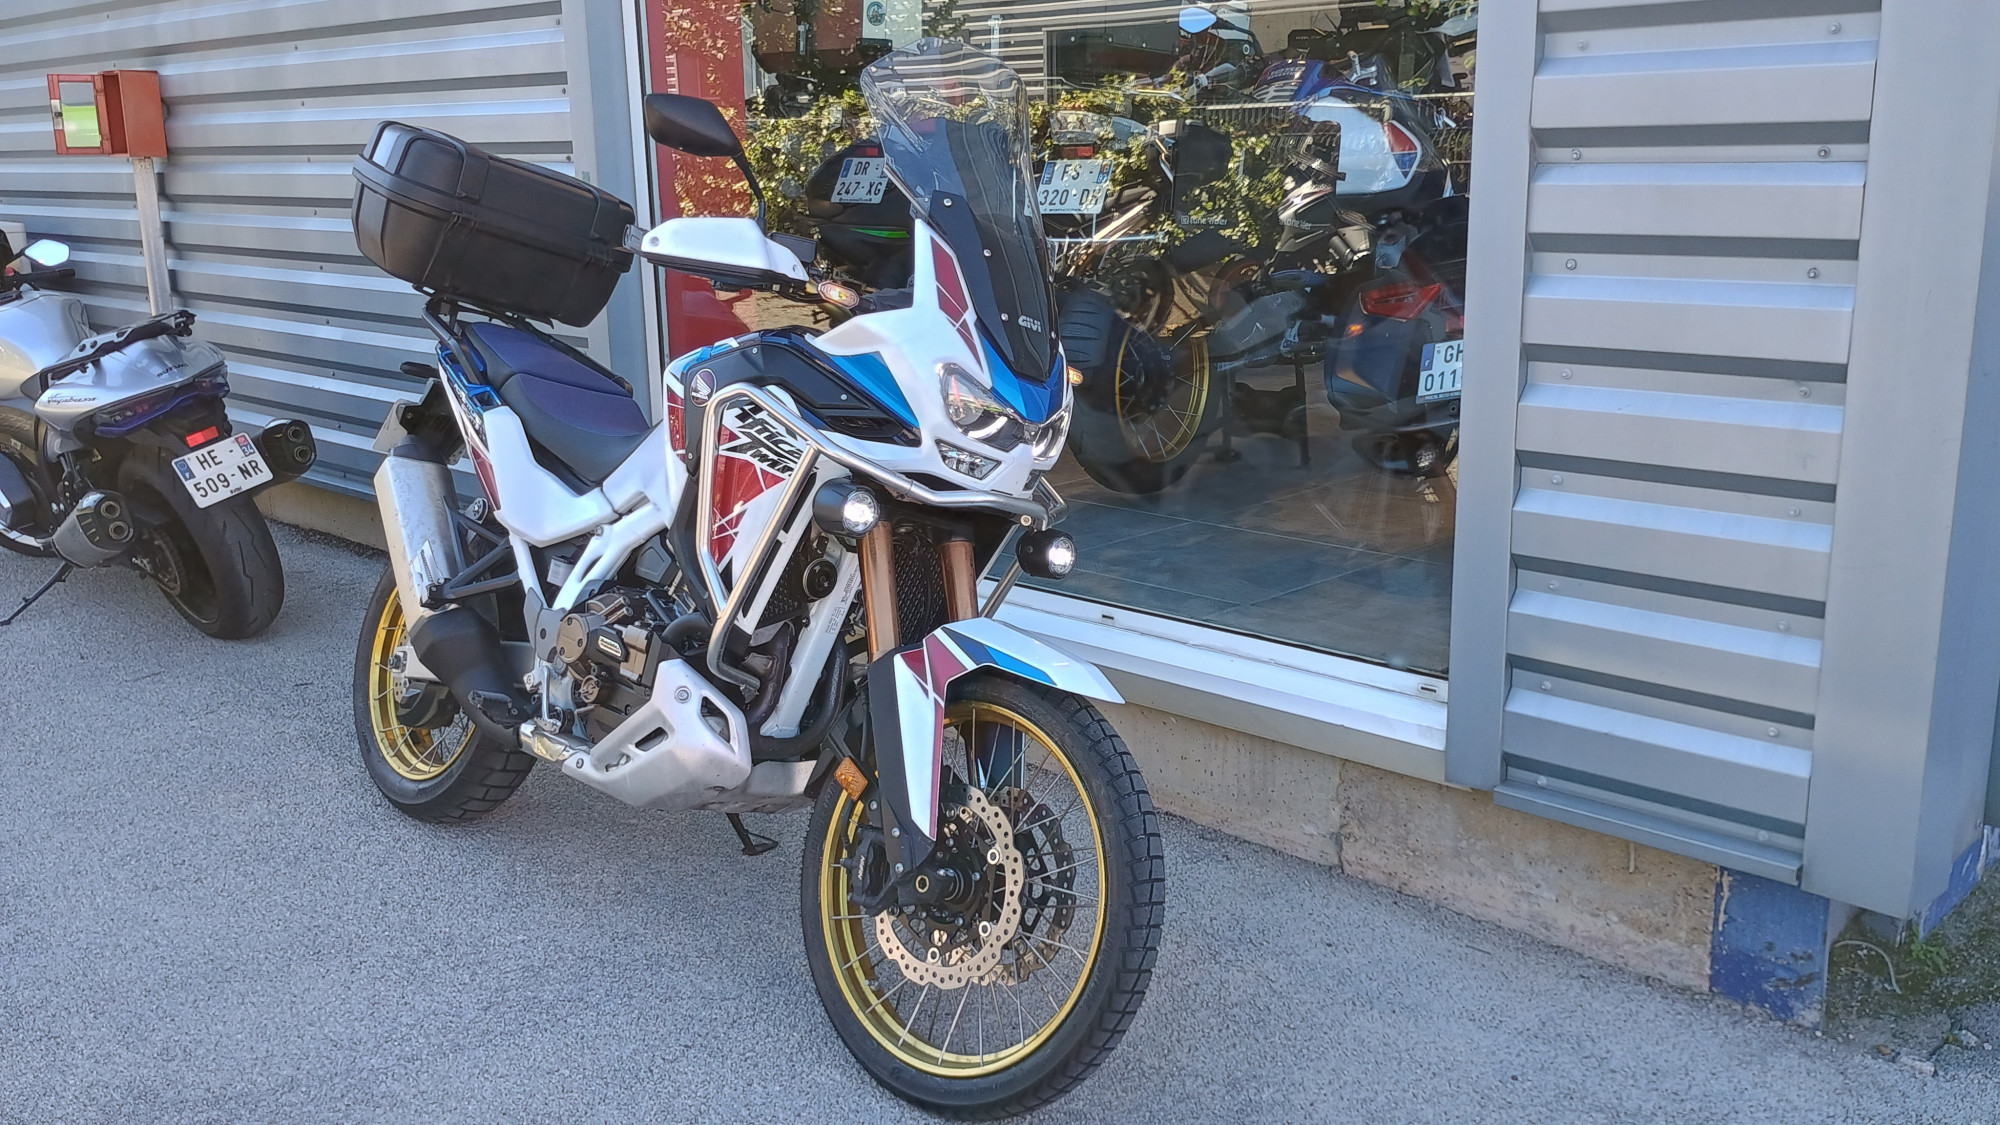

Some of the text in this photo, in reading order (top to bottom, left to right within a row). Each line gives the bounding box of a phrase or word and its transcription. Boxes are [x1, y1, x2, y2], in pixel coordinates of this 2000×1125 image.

[854, 162, 871, 175] DR
[1018, 315, 1042, 333] GIVI
[196, 449, 223, 470] HE
[193, 459, 264, 498] 509-NR
